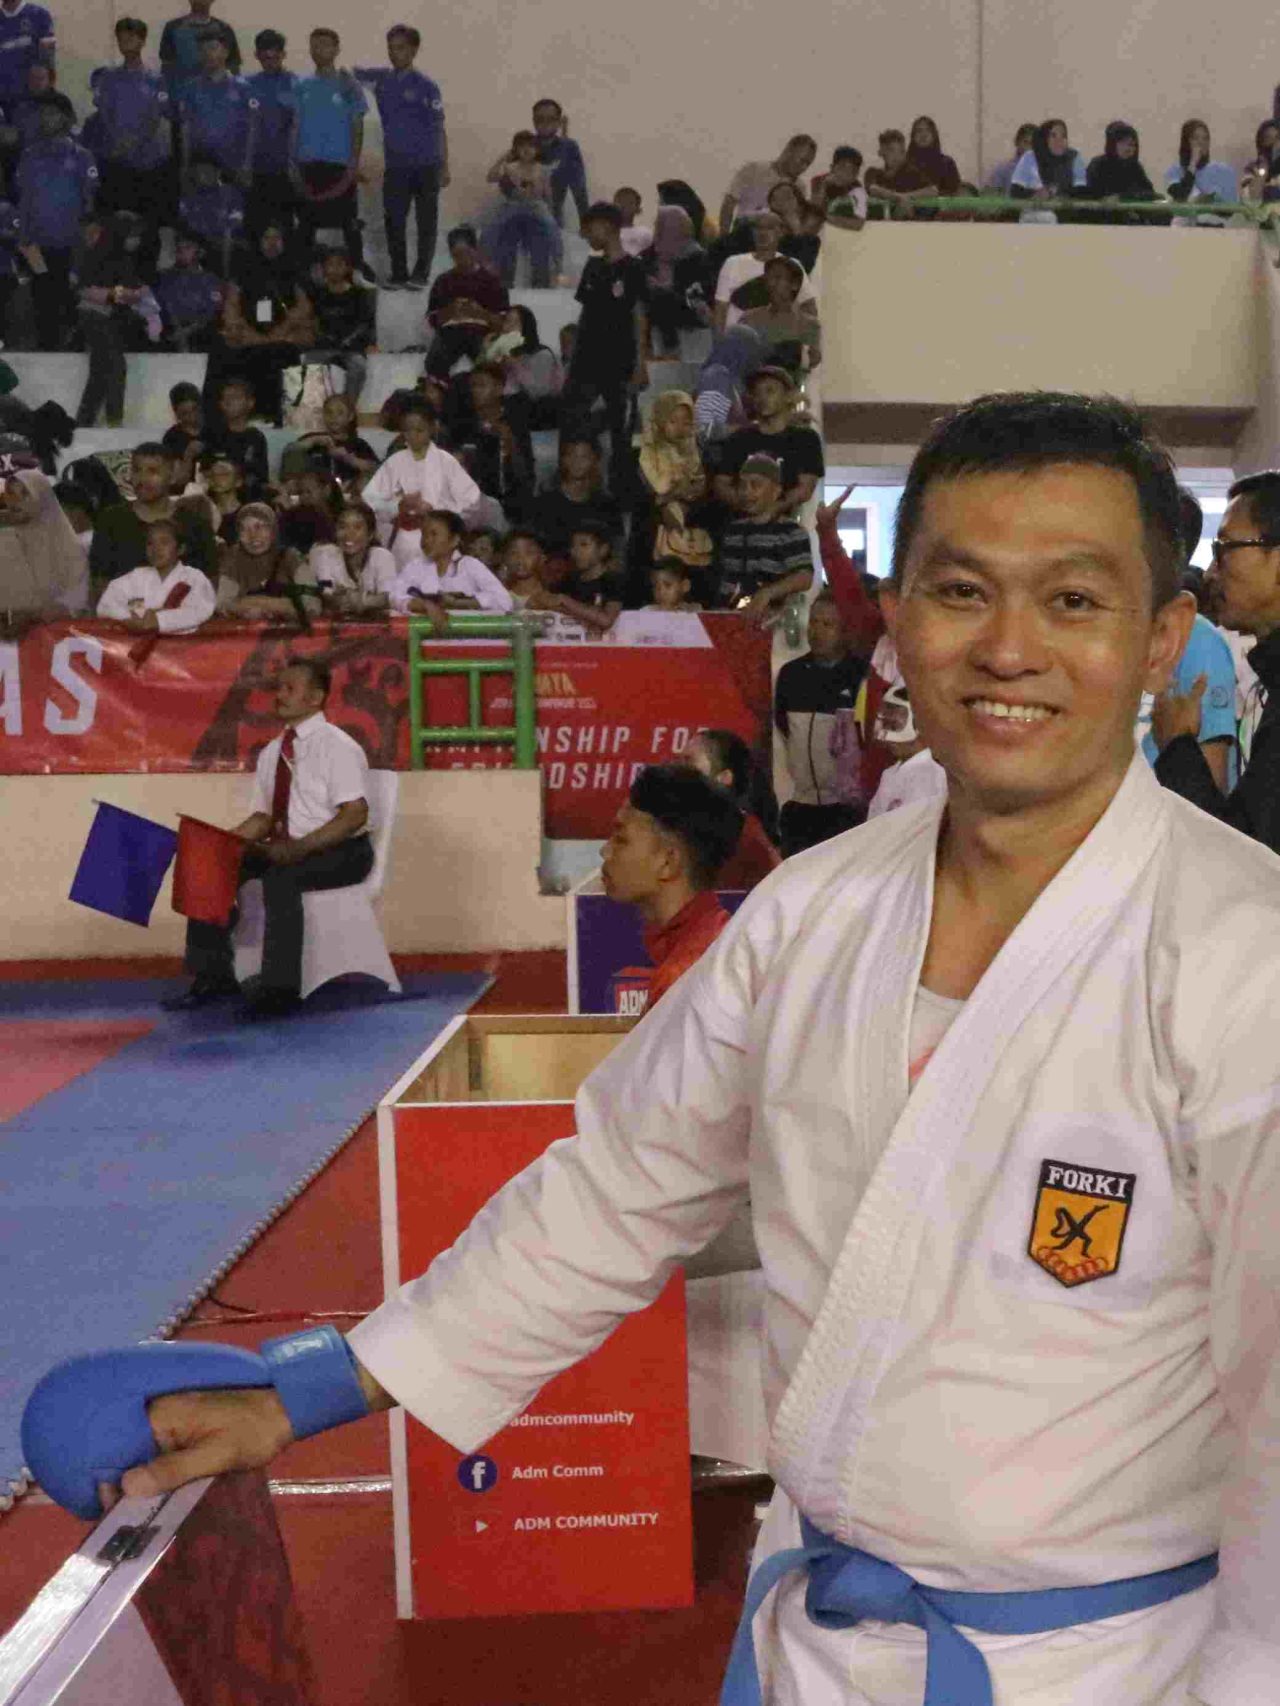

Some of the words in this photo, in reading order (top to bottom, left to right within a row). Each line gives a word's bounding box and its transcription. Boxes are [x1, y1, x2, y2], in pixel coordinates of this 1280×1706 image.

[535, 725, 631, 754] NSHIP
[1046, 1165, 1129, 1199] FORKI
[511, 1466, 548, 1480] Adm
[552, 1464, 605, 1478] Comm
[513, 1516, 551, 1531] ADM
[555, 1512, 659, 1529] COMMUNITY
